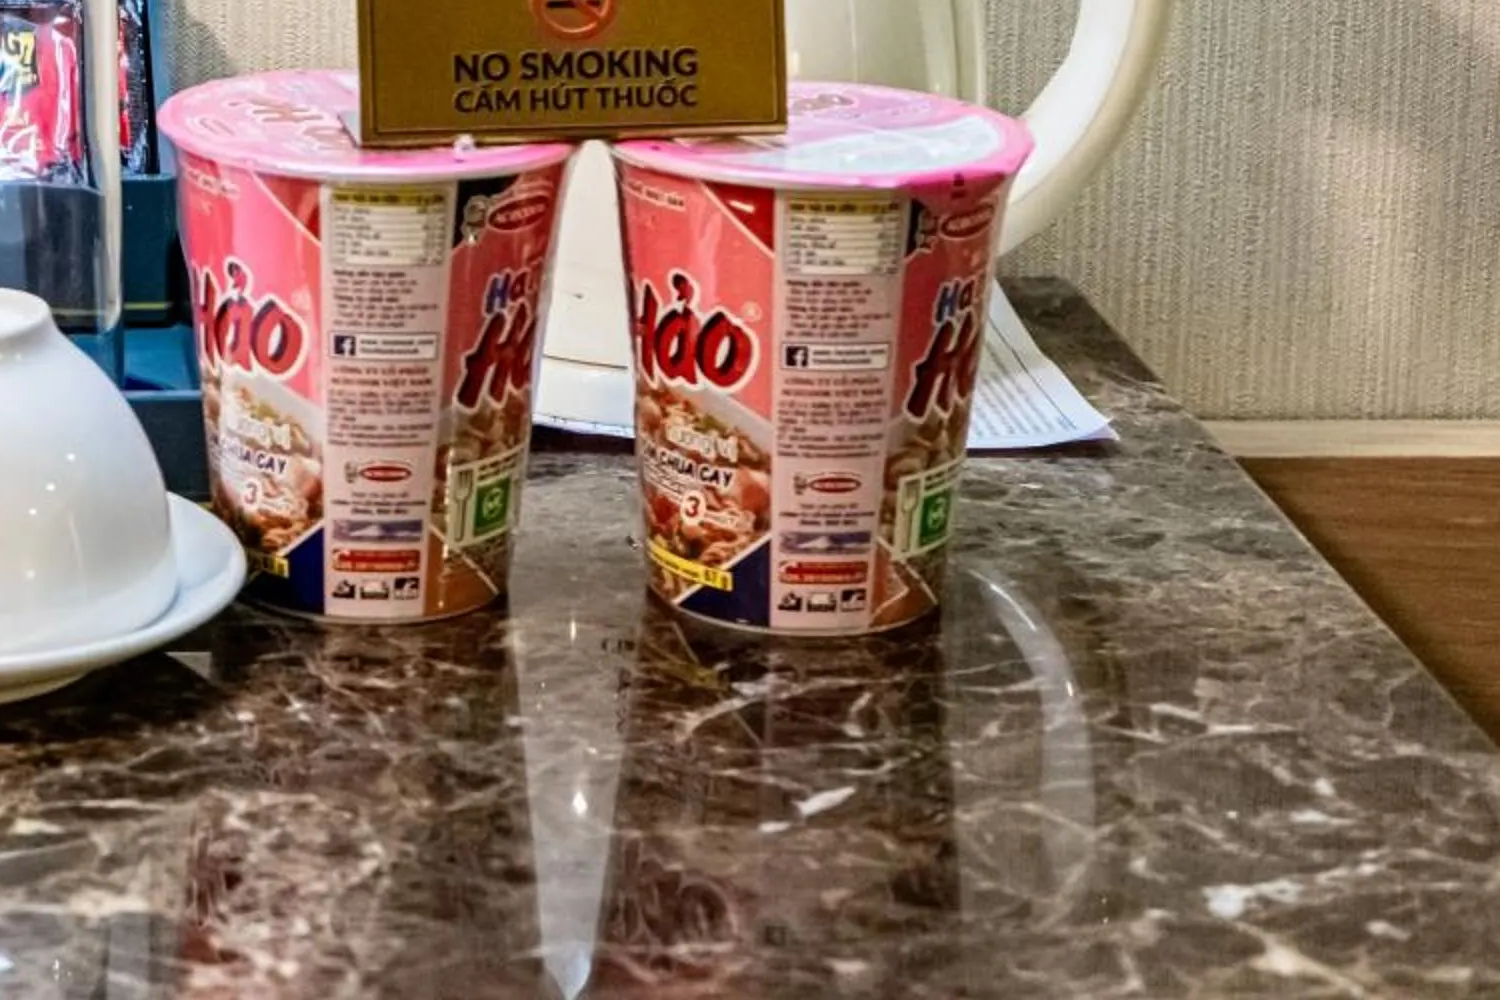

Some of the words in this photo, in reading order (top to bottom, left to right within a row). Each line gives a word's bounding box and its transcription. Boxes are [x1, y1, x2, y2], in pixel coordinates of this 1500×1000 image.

[454, 53, 510, 83] NO
[520, 48, 698, 81] SMOKING
[454, 83, 521, 113] CẤM
[529, 82, 588, 111] HÚT
[595, 77, 698, 108] THUỐC
[700, 465, 733, 487] CAY
